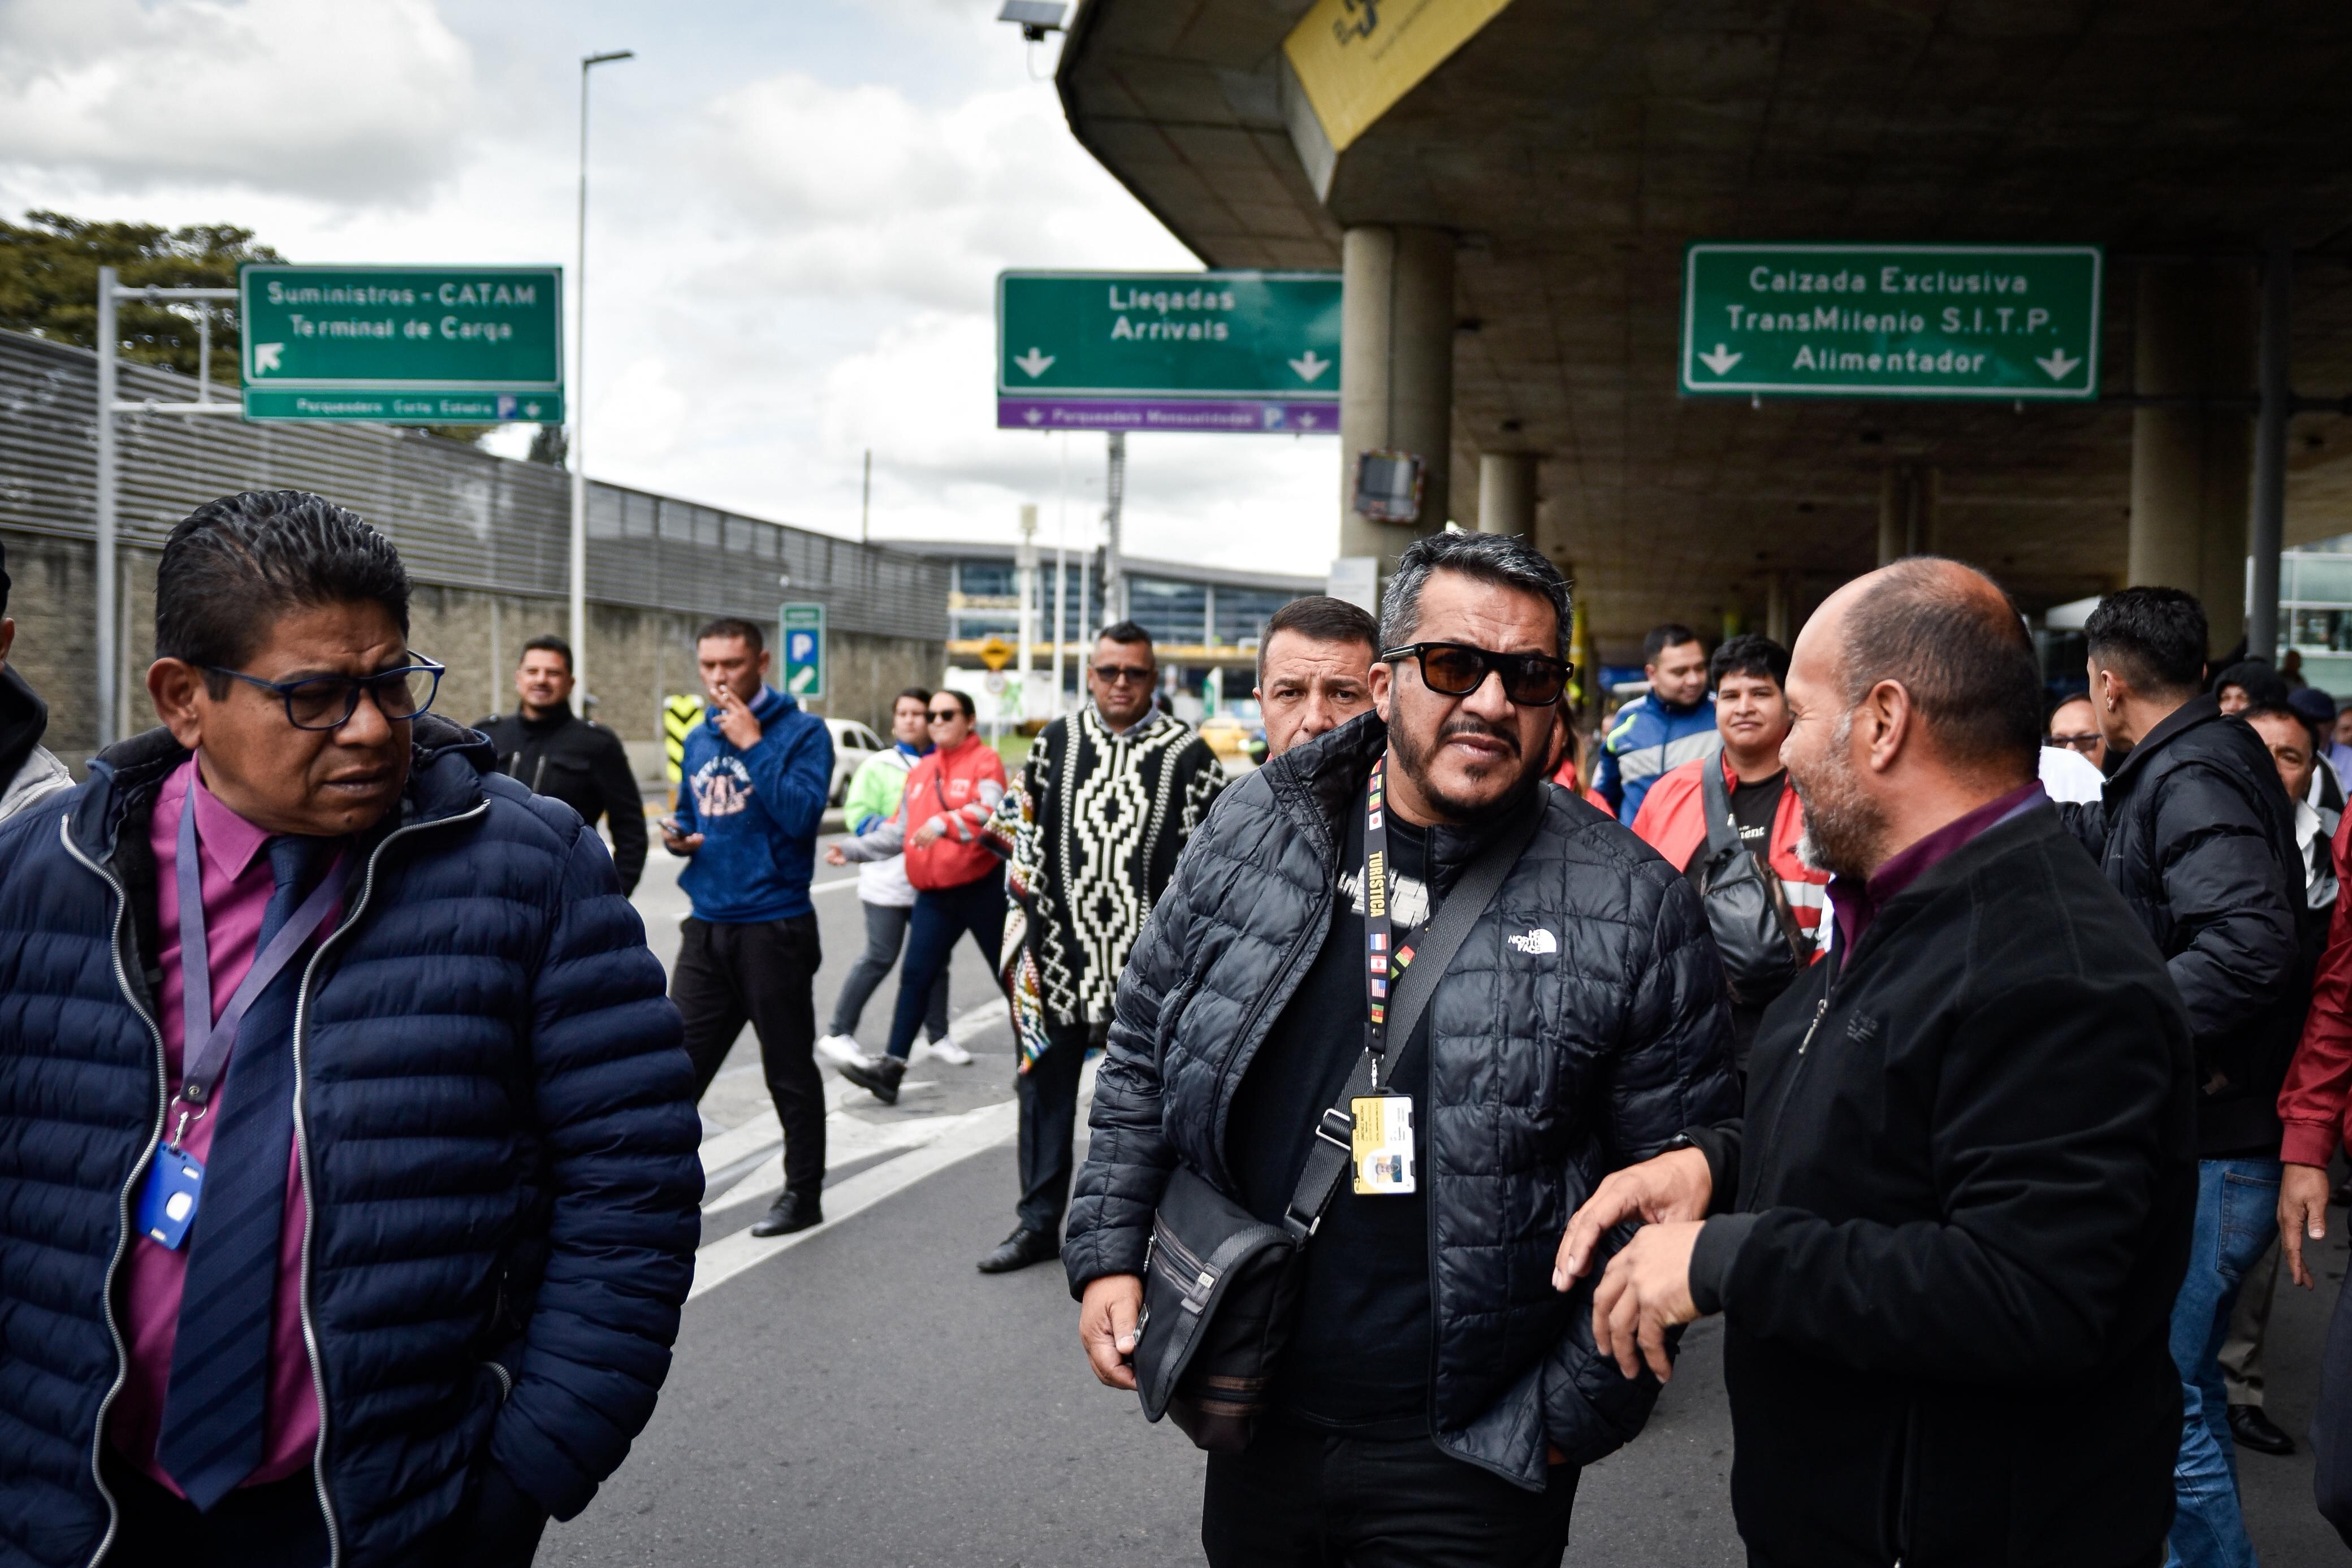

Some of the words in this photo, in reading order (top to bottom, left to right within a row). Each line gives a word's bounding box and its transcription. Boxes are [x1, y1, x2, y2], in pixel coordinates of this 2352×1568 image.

[267, 281, 415, 306] Suministros
[439, 283, 537, 307] CATAM
[1750, 266, 1866, 293] Calzada
[1880, 266, 2028, 294] Exclusiva
[1109, 285, 1235, 313] Llegadas
[289, 314, 394, 339] Terminal
[403, 318, 431, 339] de
[440, 317, 512, 344] Carga
[1111, 315, 1229, 340] Arrivals
[1726, 305, 1925, 332] TransMilenio
[1942, 307, 2059, 335] S.I.T.P.
[1792, 345, 1986, 373] Alimentador
[792, 634, 813, 662] P
[1369, 850, 1387, 917] TURÍSTICA
